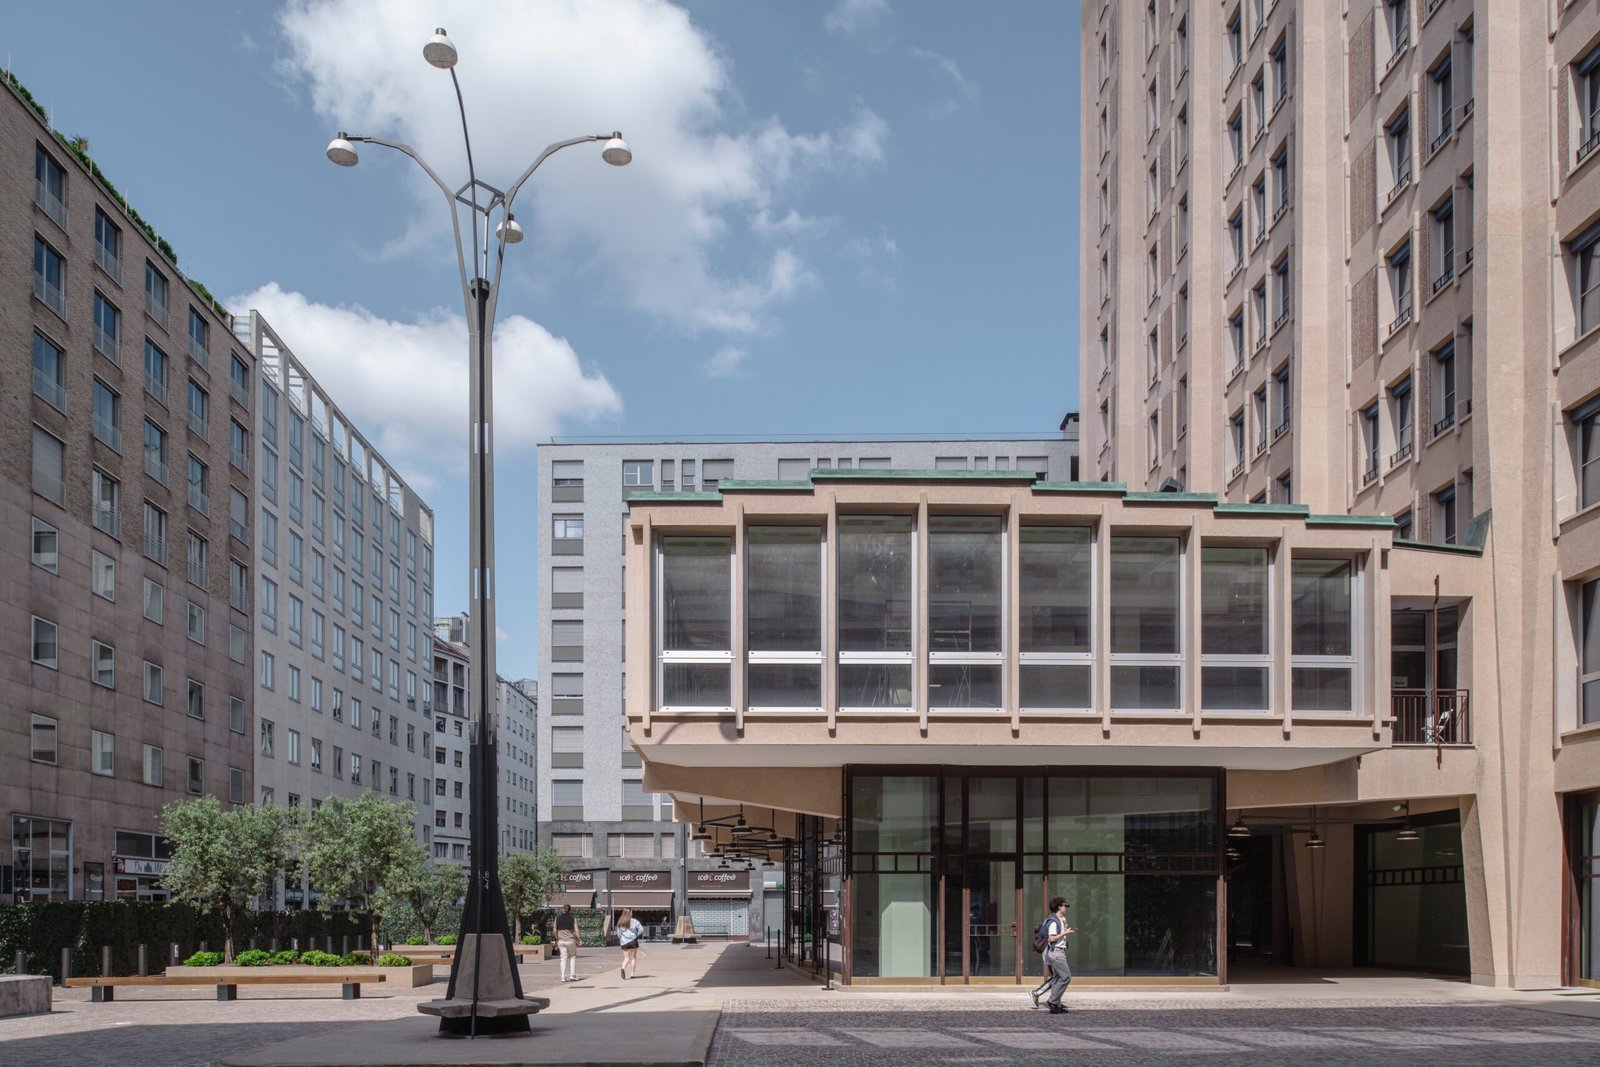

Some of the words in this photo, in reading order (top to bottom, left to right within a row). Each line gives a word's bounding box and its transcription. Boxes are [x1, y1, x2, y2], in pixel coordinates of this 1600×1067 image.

[569, 873, 592, 882] coffee
[636, 873, 658, 883] coffee
[714, 873, 736, 883] coffee
